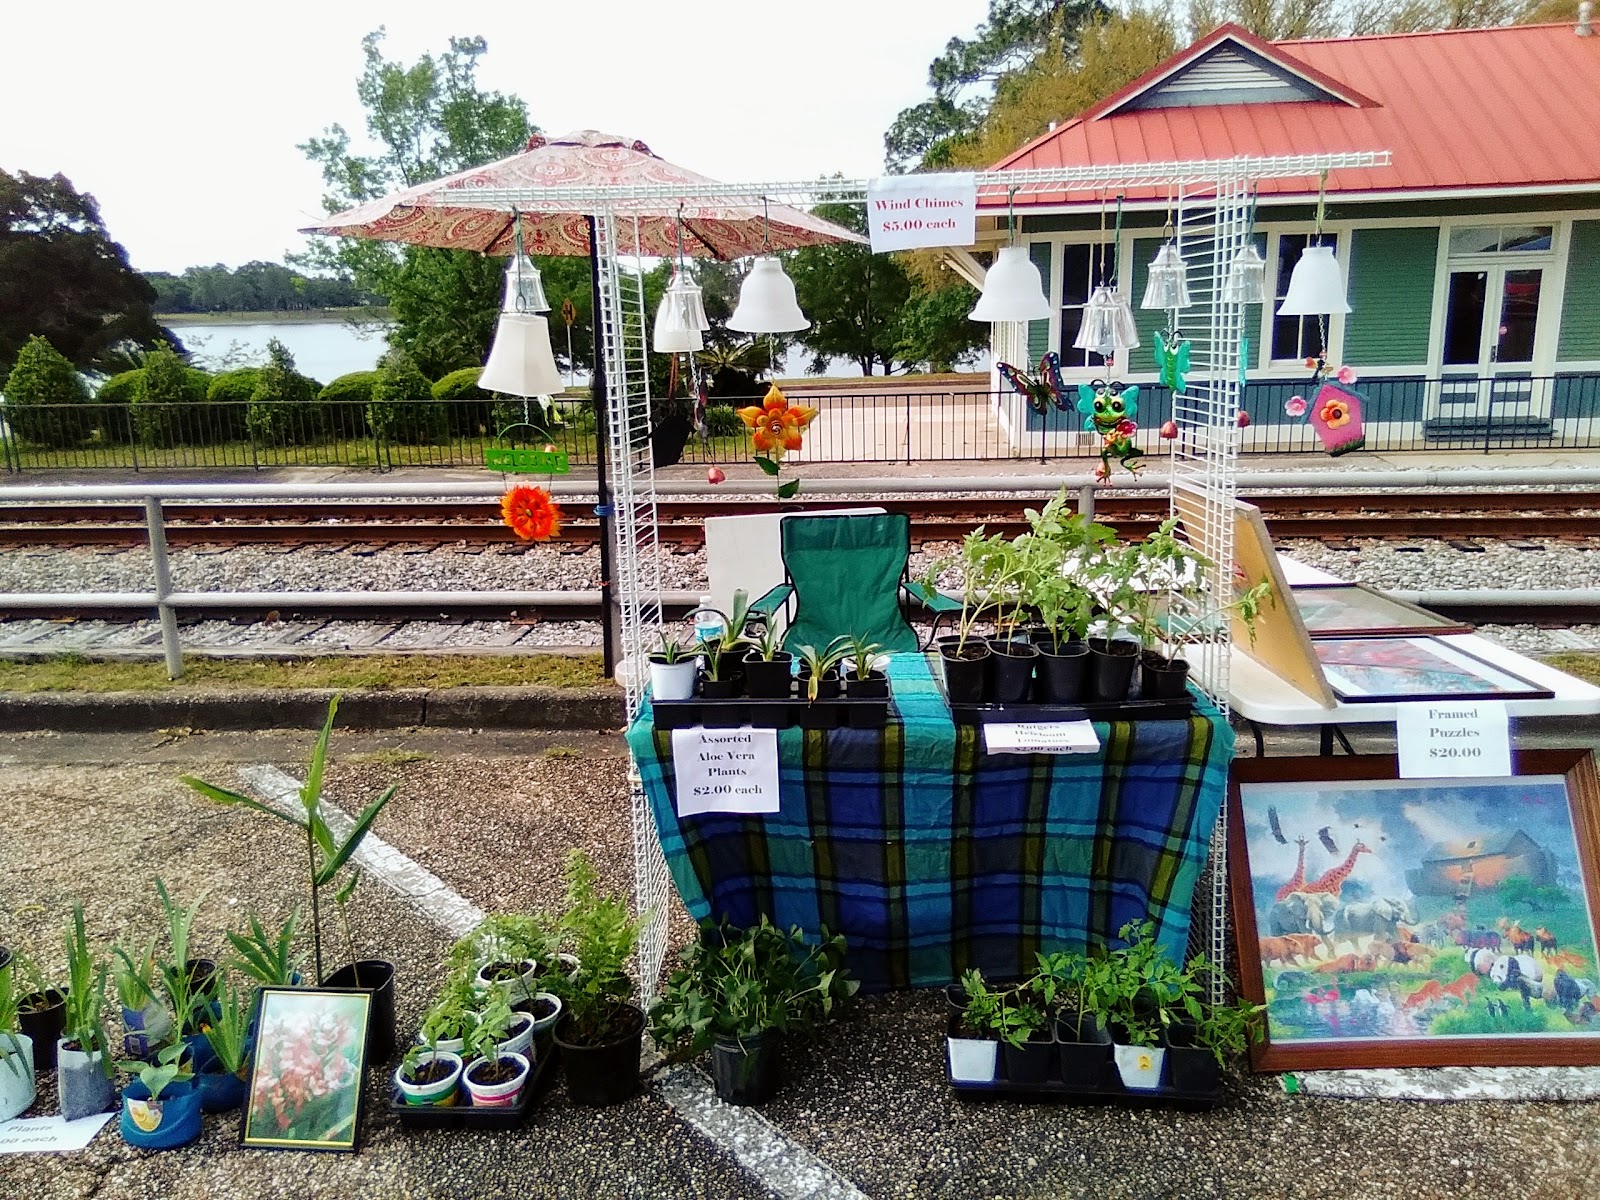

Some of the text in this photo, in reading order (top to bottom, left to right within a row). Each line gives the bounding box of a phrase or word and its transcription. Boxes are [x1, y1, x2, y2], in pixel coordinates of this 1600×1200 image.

[875, 198, 964, 211] Wind Chimes
[883, 218, 956, 232] $5.00 each
[1428, 708, 1478, 719] Framed
[1430, 727, 1480, 738] Puzzles
[699, 735, 751, 743] Assorted
[698, 751, 755, 761] Aloe Vera
[1429, 747, 1481, 758] $20.00
[708, 768, 747, 776] Plants
[693, 785, 762, 796] $2.00 each
